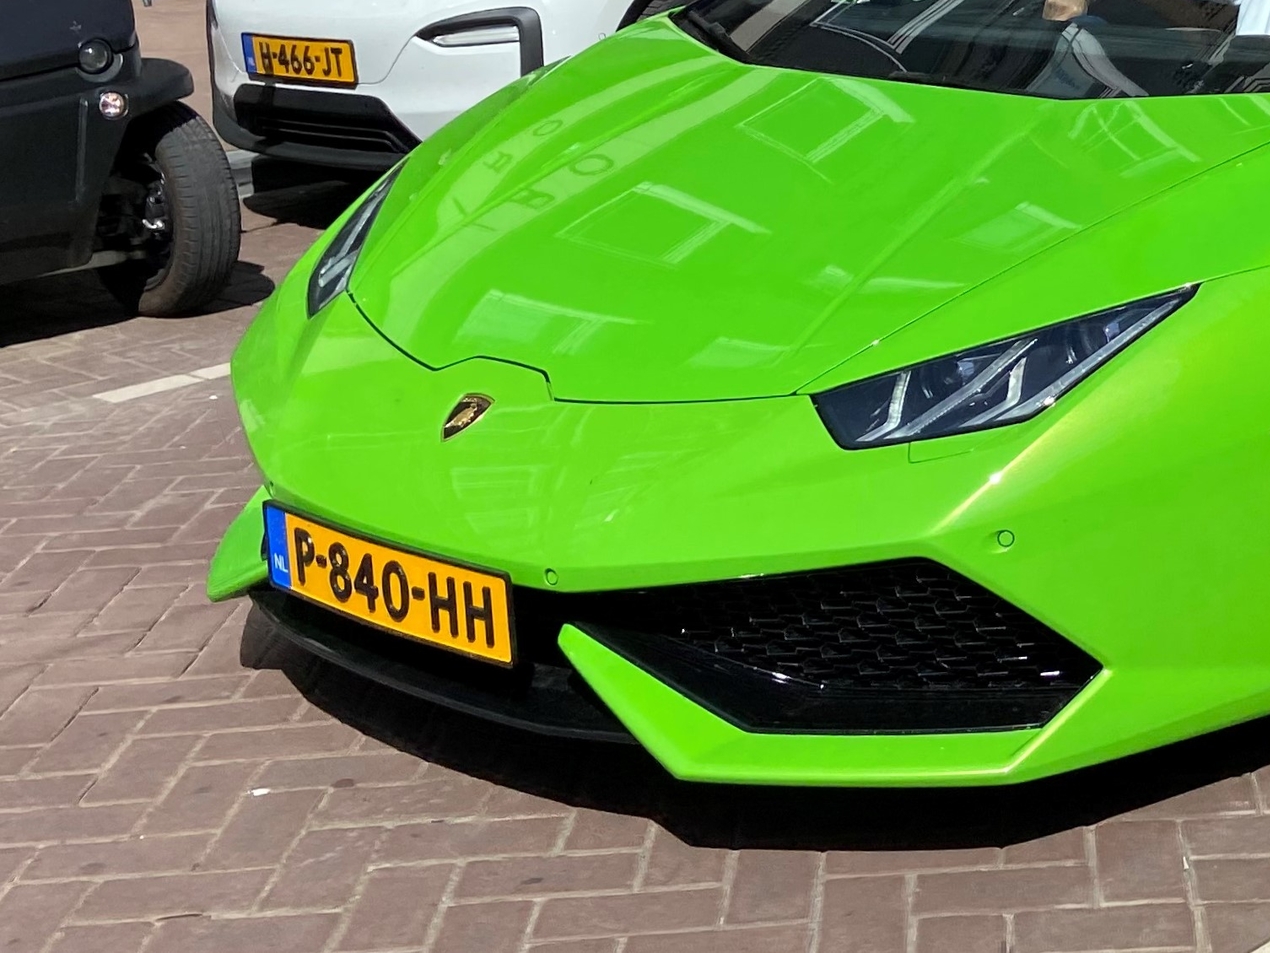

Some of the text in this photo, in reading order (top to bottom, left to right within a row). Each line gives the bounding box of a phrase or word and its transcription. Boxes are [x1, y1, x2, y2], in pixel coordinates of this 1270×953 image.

[258, 41, 343, 78] H-466-JT
[274, 553, 289, 574] NL
[293, 526, 496, 649] P-840-HH
